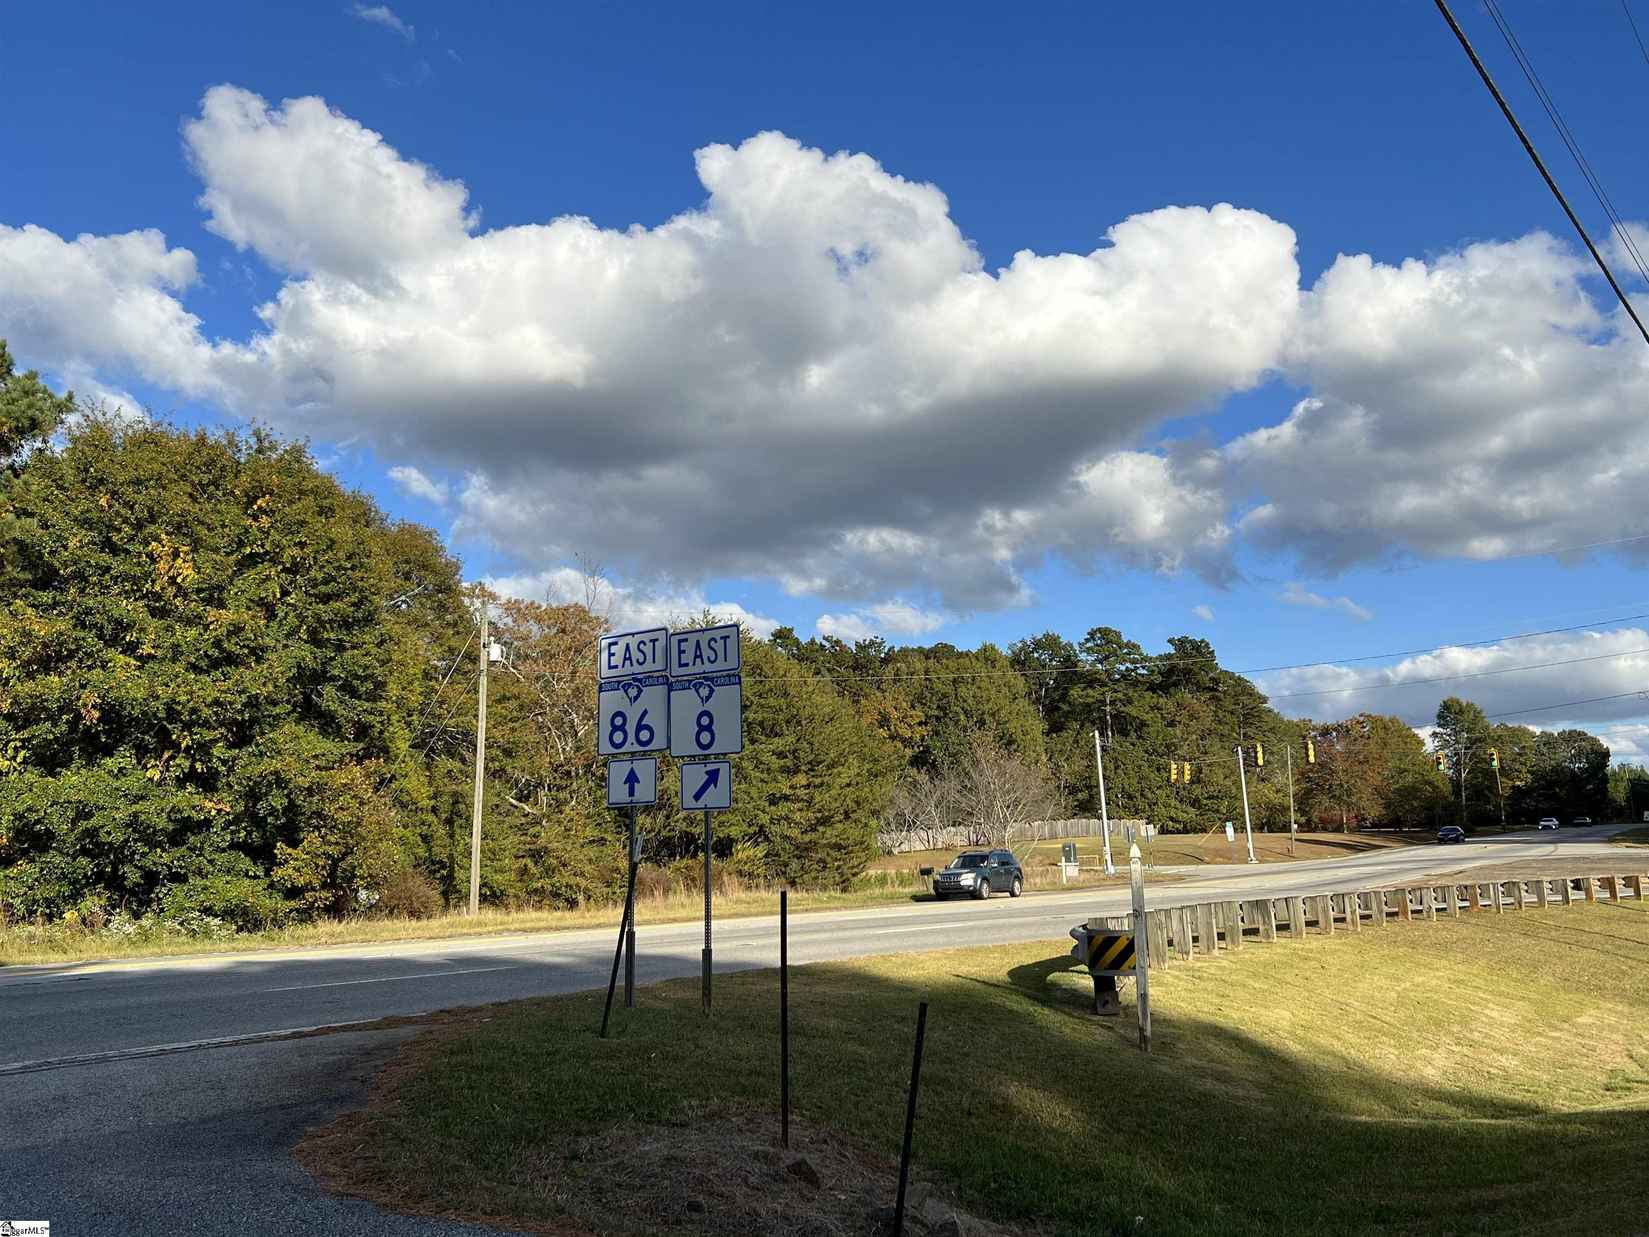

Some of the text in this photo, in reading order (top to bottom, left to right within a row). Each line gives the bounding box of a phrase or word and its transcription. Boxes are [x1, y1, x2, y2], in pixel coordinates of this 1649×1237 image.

[607, 638, 660, 670] EAST
[677, 635, 731, 669] EAST
[672, 676, 740, 690] SOUTH CAROLINA
[608, 708, 655, 750] 86
[695, 709, 716, 751] 8
